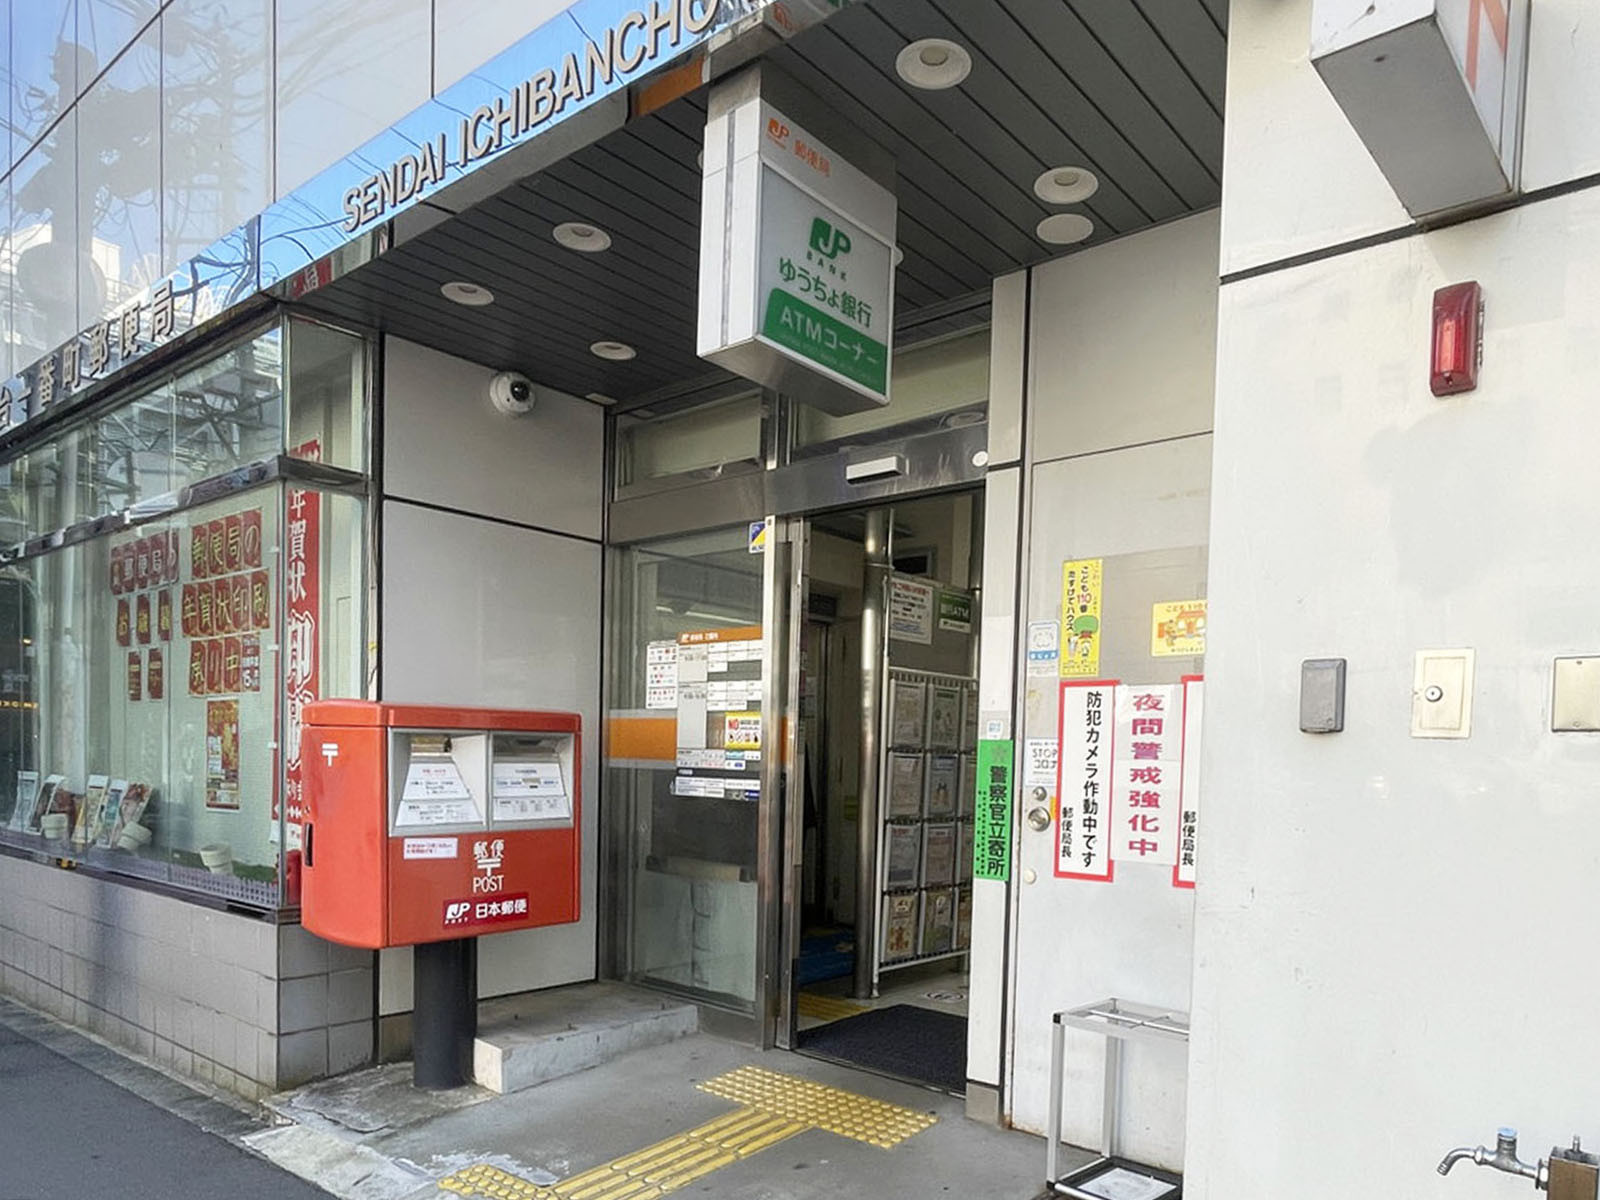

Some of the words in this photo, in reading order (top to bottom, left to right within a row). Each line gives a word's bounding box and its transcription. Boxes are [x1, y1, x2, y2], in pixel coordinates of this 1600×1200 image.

[341, 132, 446, 233] SENDAI
[458, 0, 718, 169] ICHIBANCHO
[778, 257, 872, 328] ゆうちょ銀行
[780, 306, 877, 364] ATMコーナー
[1082, 691, 1102, 867] 防犯カメラ作動中です
[1128, 693, 1165, 856] 夜間警戒強化中
[474, 839, 504, 860] 郵便
[987, 765, 1007, 876] 警察官立寄所
[1061, 807, 1073, 858] 郵便局長
[1182, 811, 1196, 866] 郵便局長
[473, 875, 504, 893] POST
[476, 899, 527, 918] 日本郵便
